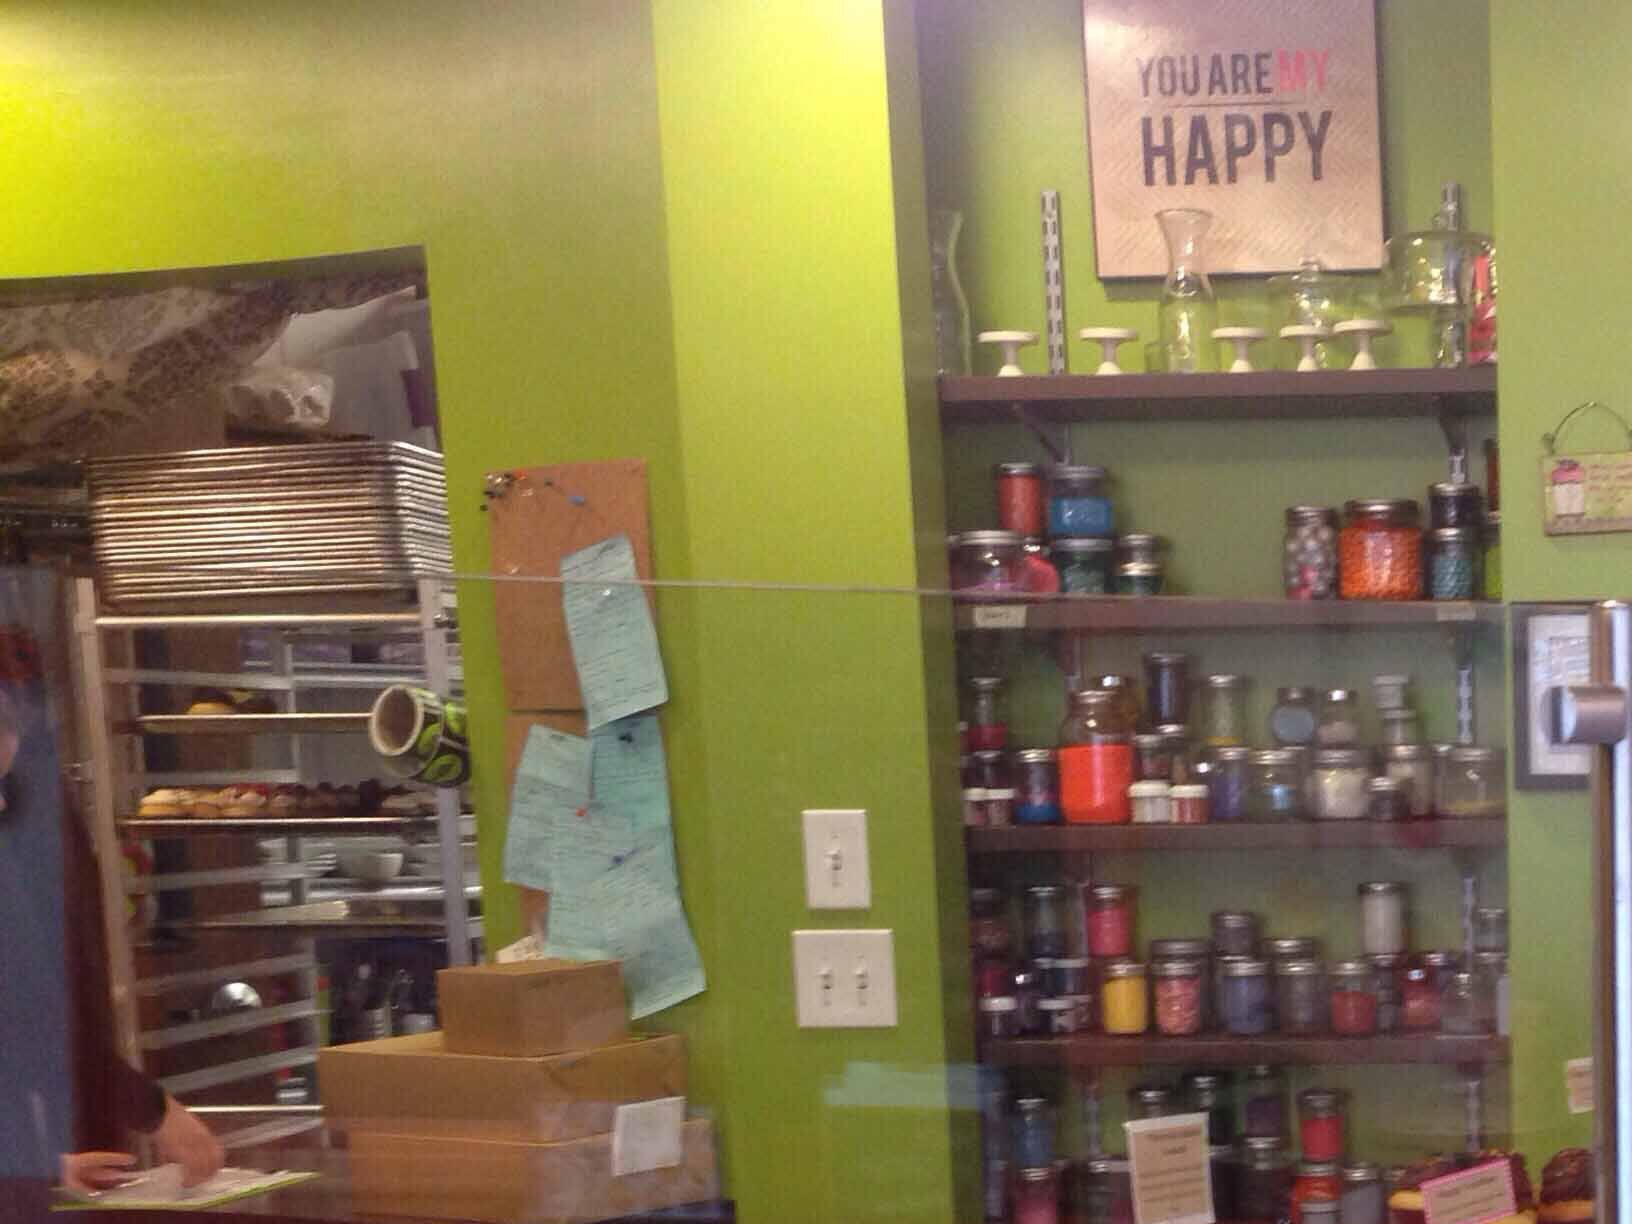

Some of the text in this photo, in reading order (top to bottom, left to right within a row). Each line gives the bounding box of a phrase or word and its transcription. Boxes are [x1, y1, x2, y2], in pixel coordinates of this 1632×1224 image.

[1137, 49, 1329, 97] YOU ARE MY
[1141, 110, 1332, 187] HAPPY
